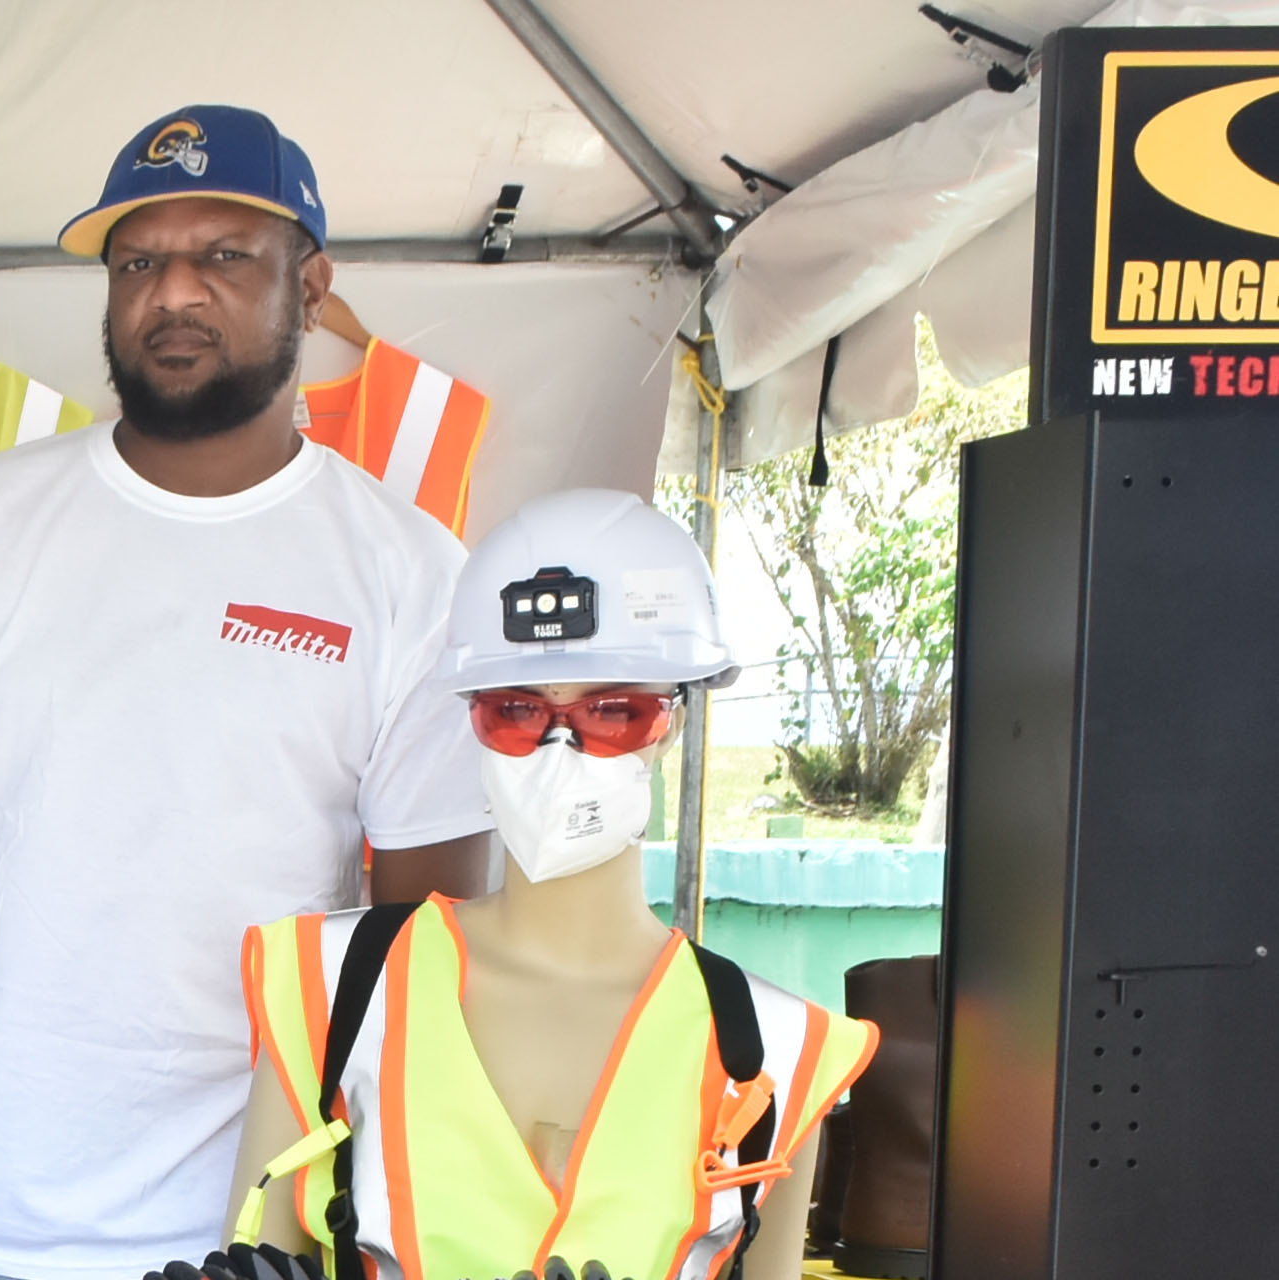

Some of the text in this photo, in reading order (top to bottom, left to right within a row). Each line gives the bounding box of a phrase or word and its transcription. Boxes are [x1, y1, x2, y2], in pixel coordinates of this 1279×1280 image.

[1092, 356, 1174, 396] NEW
[534, 622, 562, 632] KLEIN
[534, 629, 563, 638] TOOLS
